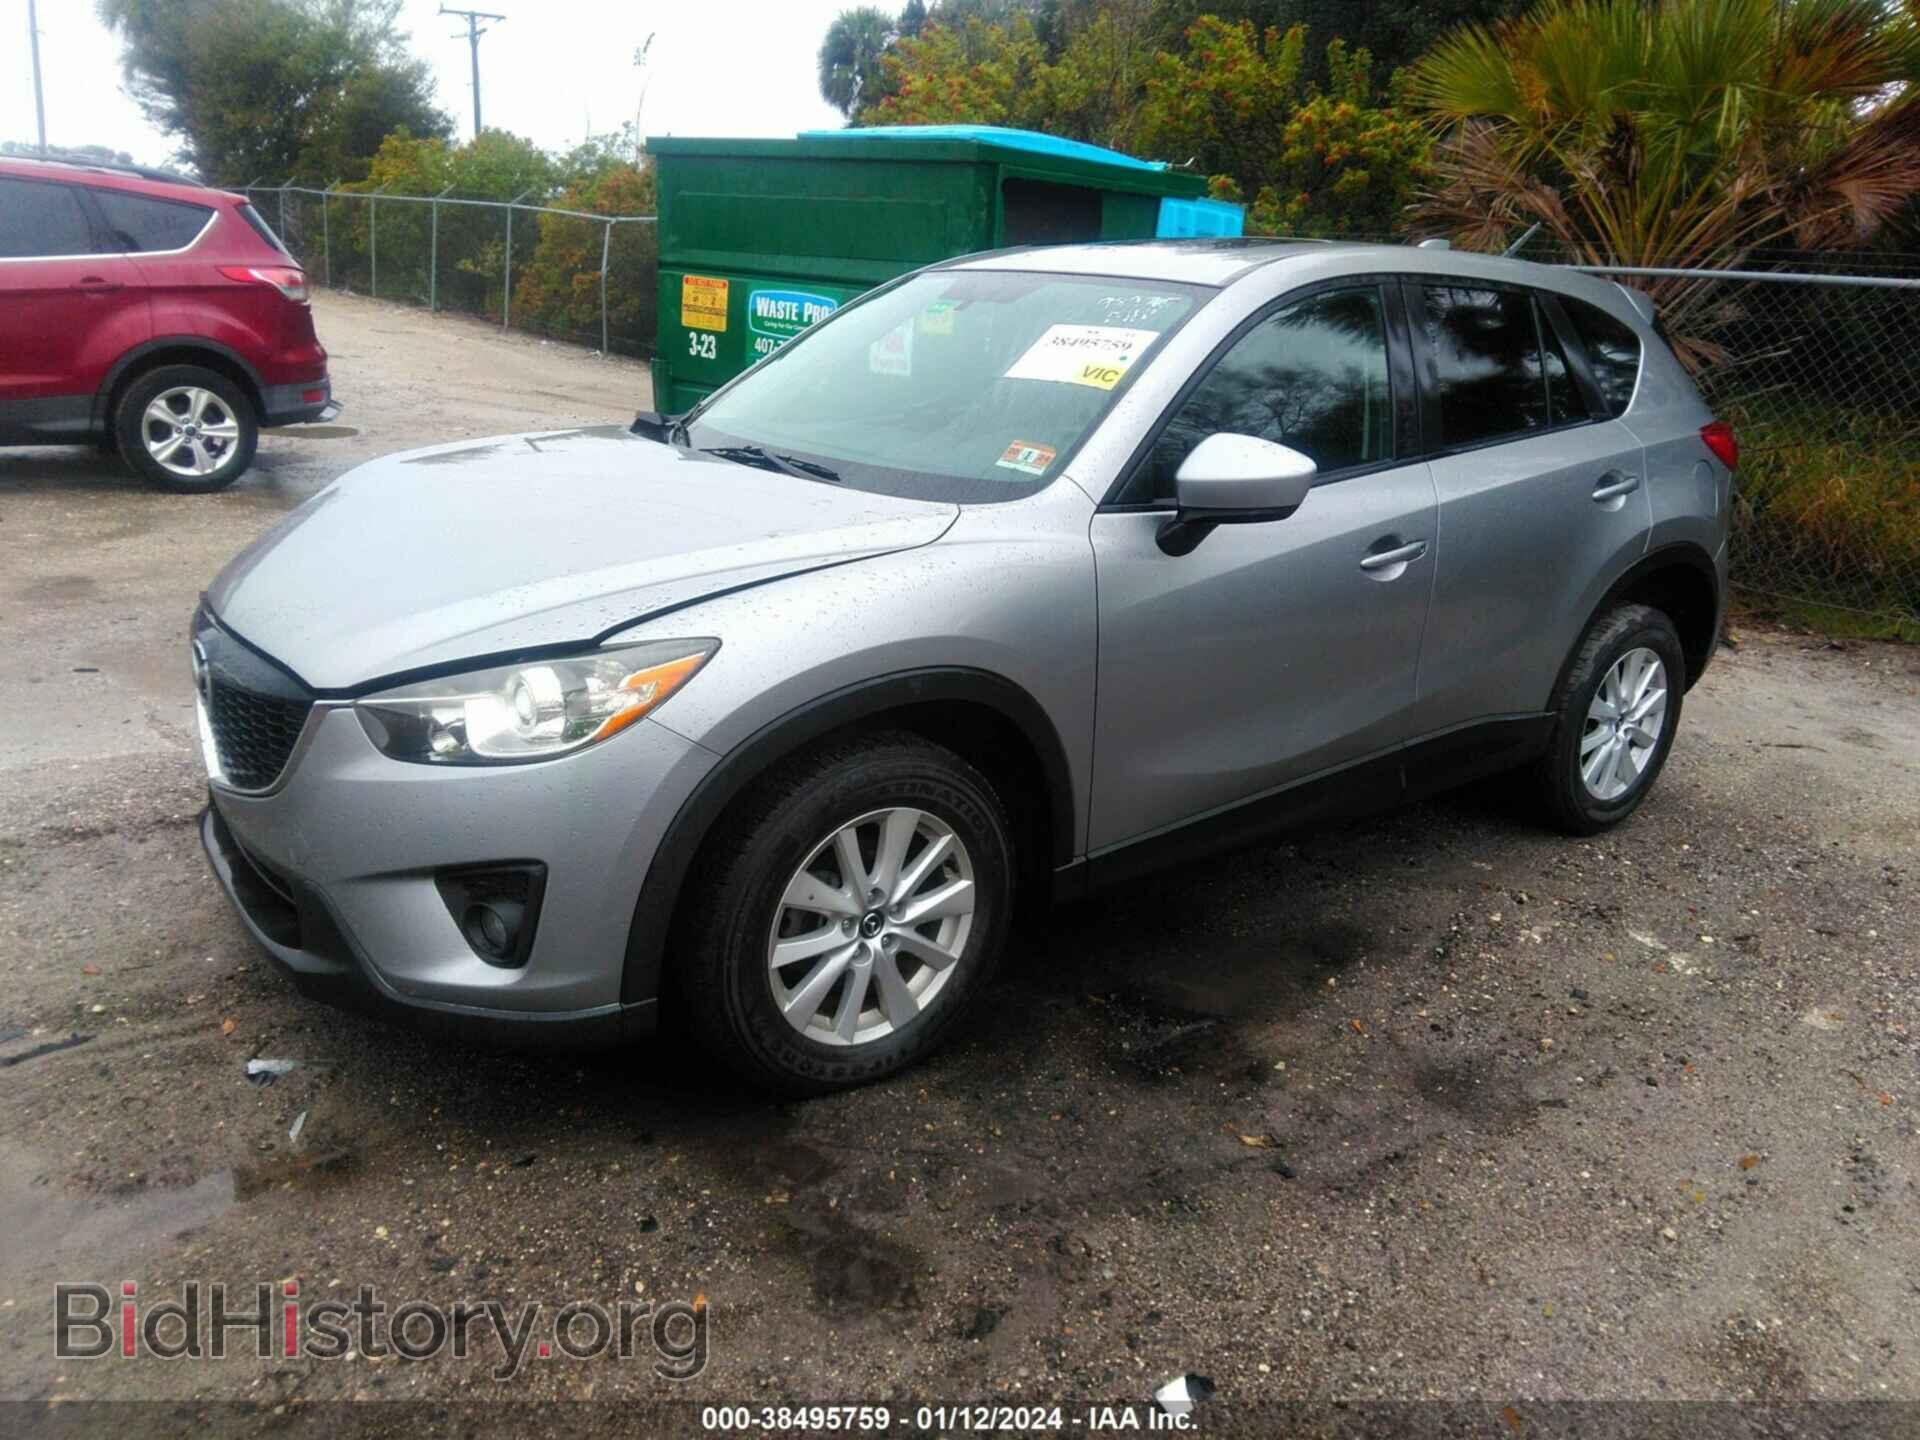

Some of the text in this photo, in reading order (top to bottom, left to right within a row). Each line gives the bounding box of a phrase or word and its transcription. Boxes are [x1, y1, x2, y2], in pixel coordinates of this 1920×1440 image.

[756, 296, 798, 321] WASTE
[803, 302, 829, 324] PRO
[688, 331, 717, 360] 3-23
[1082, 364, 1119, 383] VIC
